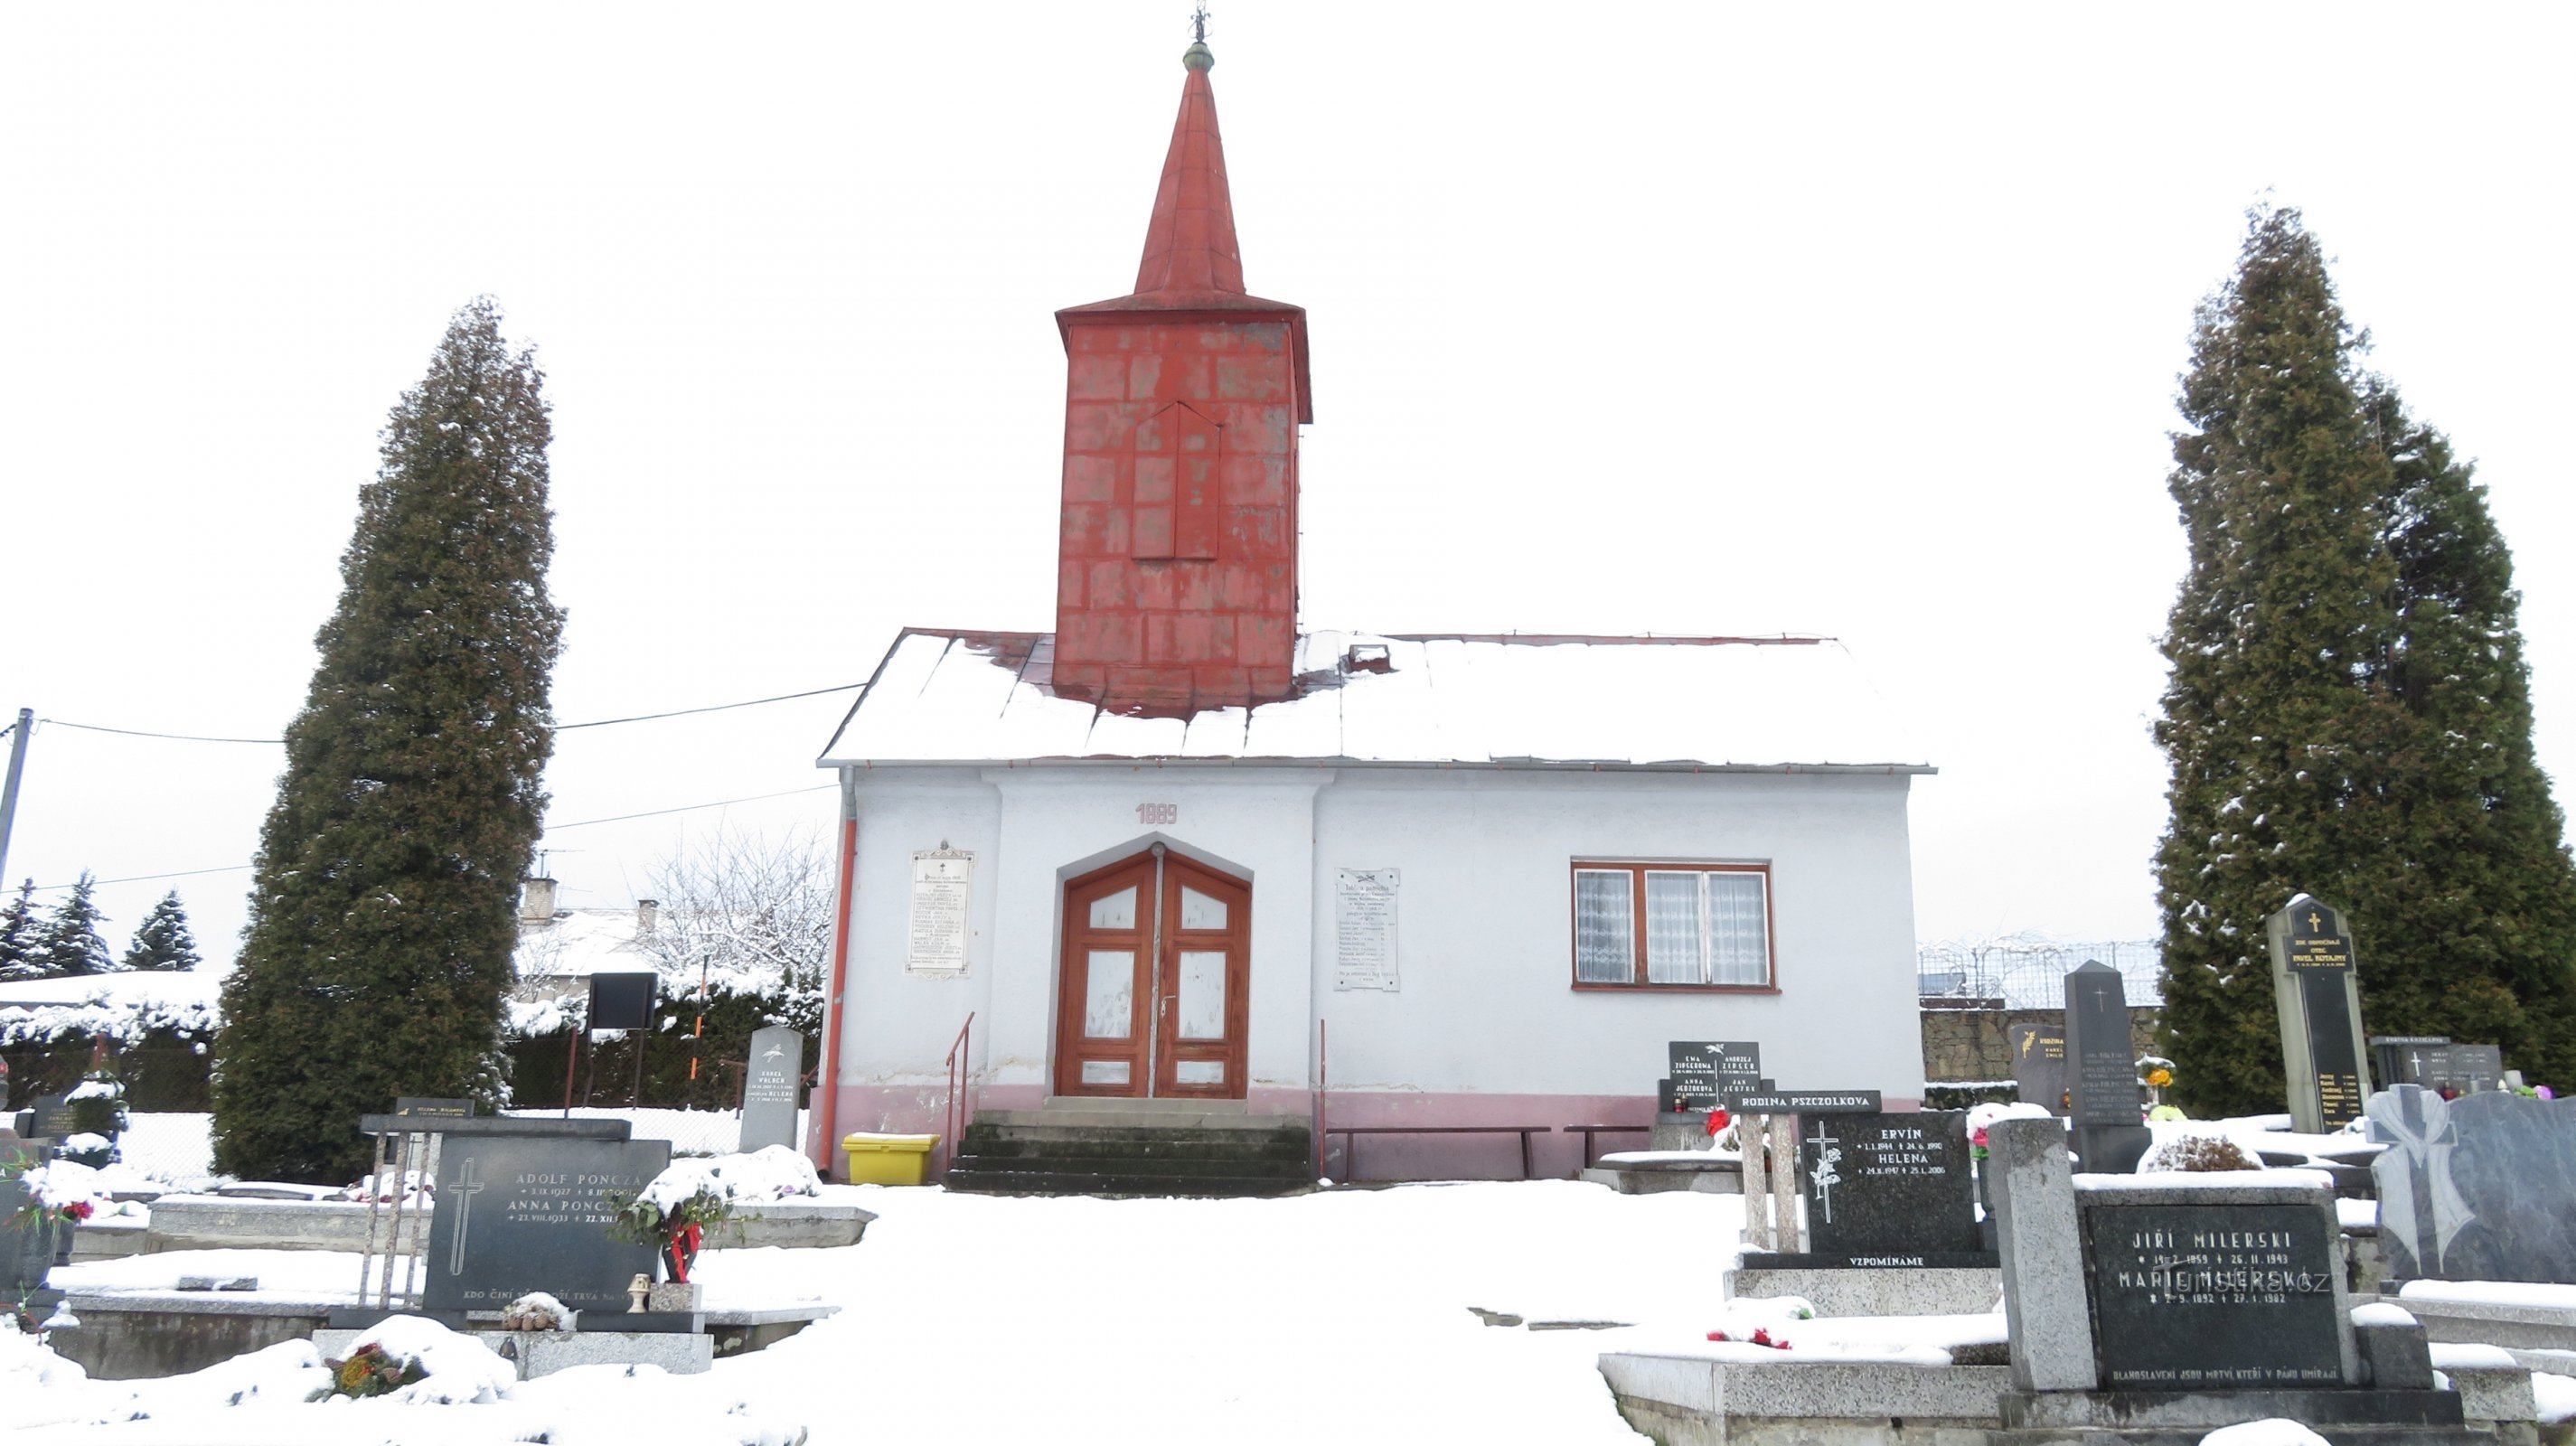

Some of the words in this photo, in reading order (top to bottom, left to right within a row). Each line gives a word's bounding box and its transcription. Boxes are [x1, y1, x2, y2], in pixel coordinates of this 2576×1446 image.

[1135, 803, 1177, 824] 1889
[1742, 1097, 1787, 1107] RODINA
[1881, 1126, 1923, 1140] ERVÍN
[1878, 1153, 1929, 1164] HELENA
[515, 1174, 568, 1185] ADOLF
[578, 1174, 642, 1185] PONCZA
[506, 1200, 550, 1211] ANNA
[2133, 1228, 2174, 1248] JIŘÍ
[2194, 1232, 2291, 1248] MILERSKI
[1849, 1254, 1924, 1266] VZPOMÍNÁME
[2119, 1272, 2186, 1287] MARIE
[464, 1291, 484, 1299] KDO
